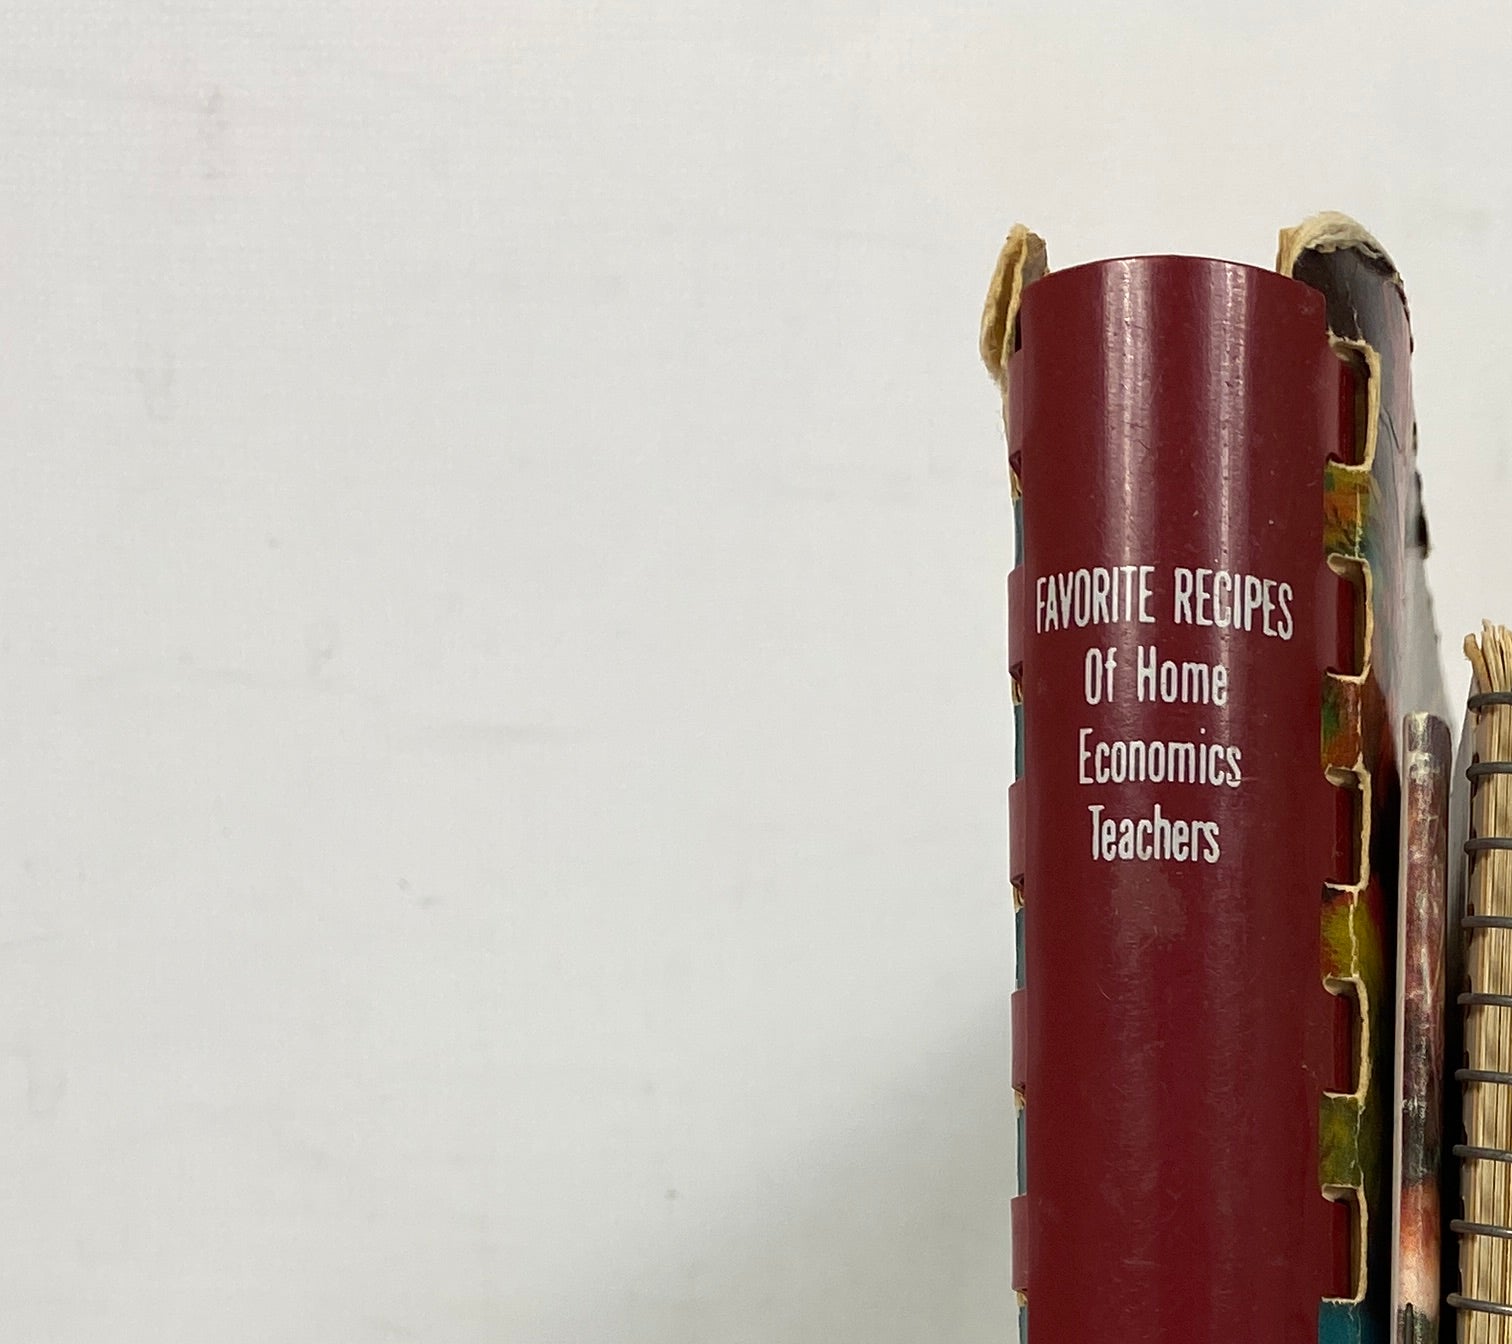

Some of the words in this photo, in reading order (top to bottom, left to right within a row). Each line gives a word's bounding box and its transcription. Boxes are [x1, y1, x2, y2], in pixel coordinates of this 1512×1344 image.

[1036, 565, 1156, 634] FAVORITE
[1174, 567, 1293, 641] RECIPES
[1085, 646, 1118, 705] Of
[1137, 645, 1229, 705] Home
[1079, 727, 1242, 788] Economics
[1087, 803, 1220, 864] Teachers
